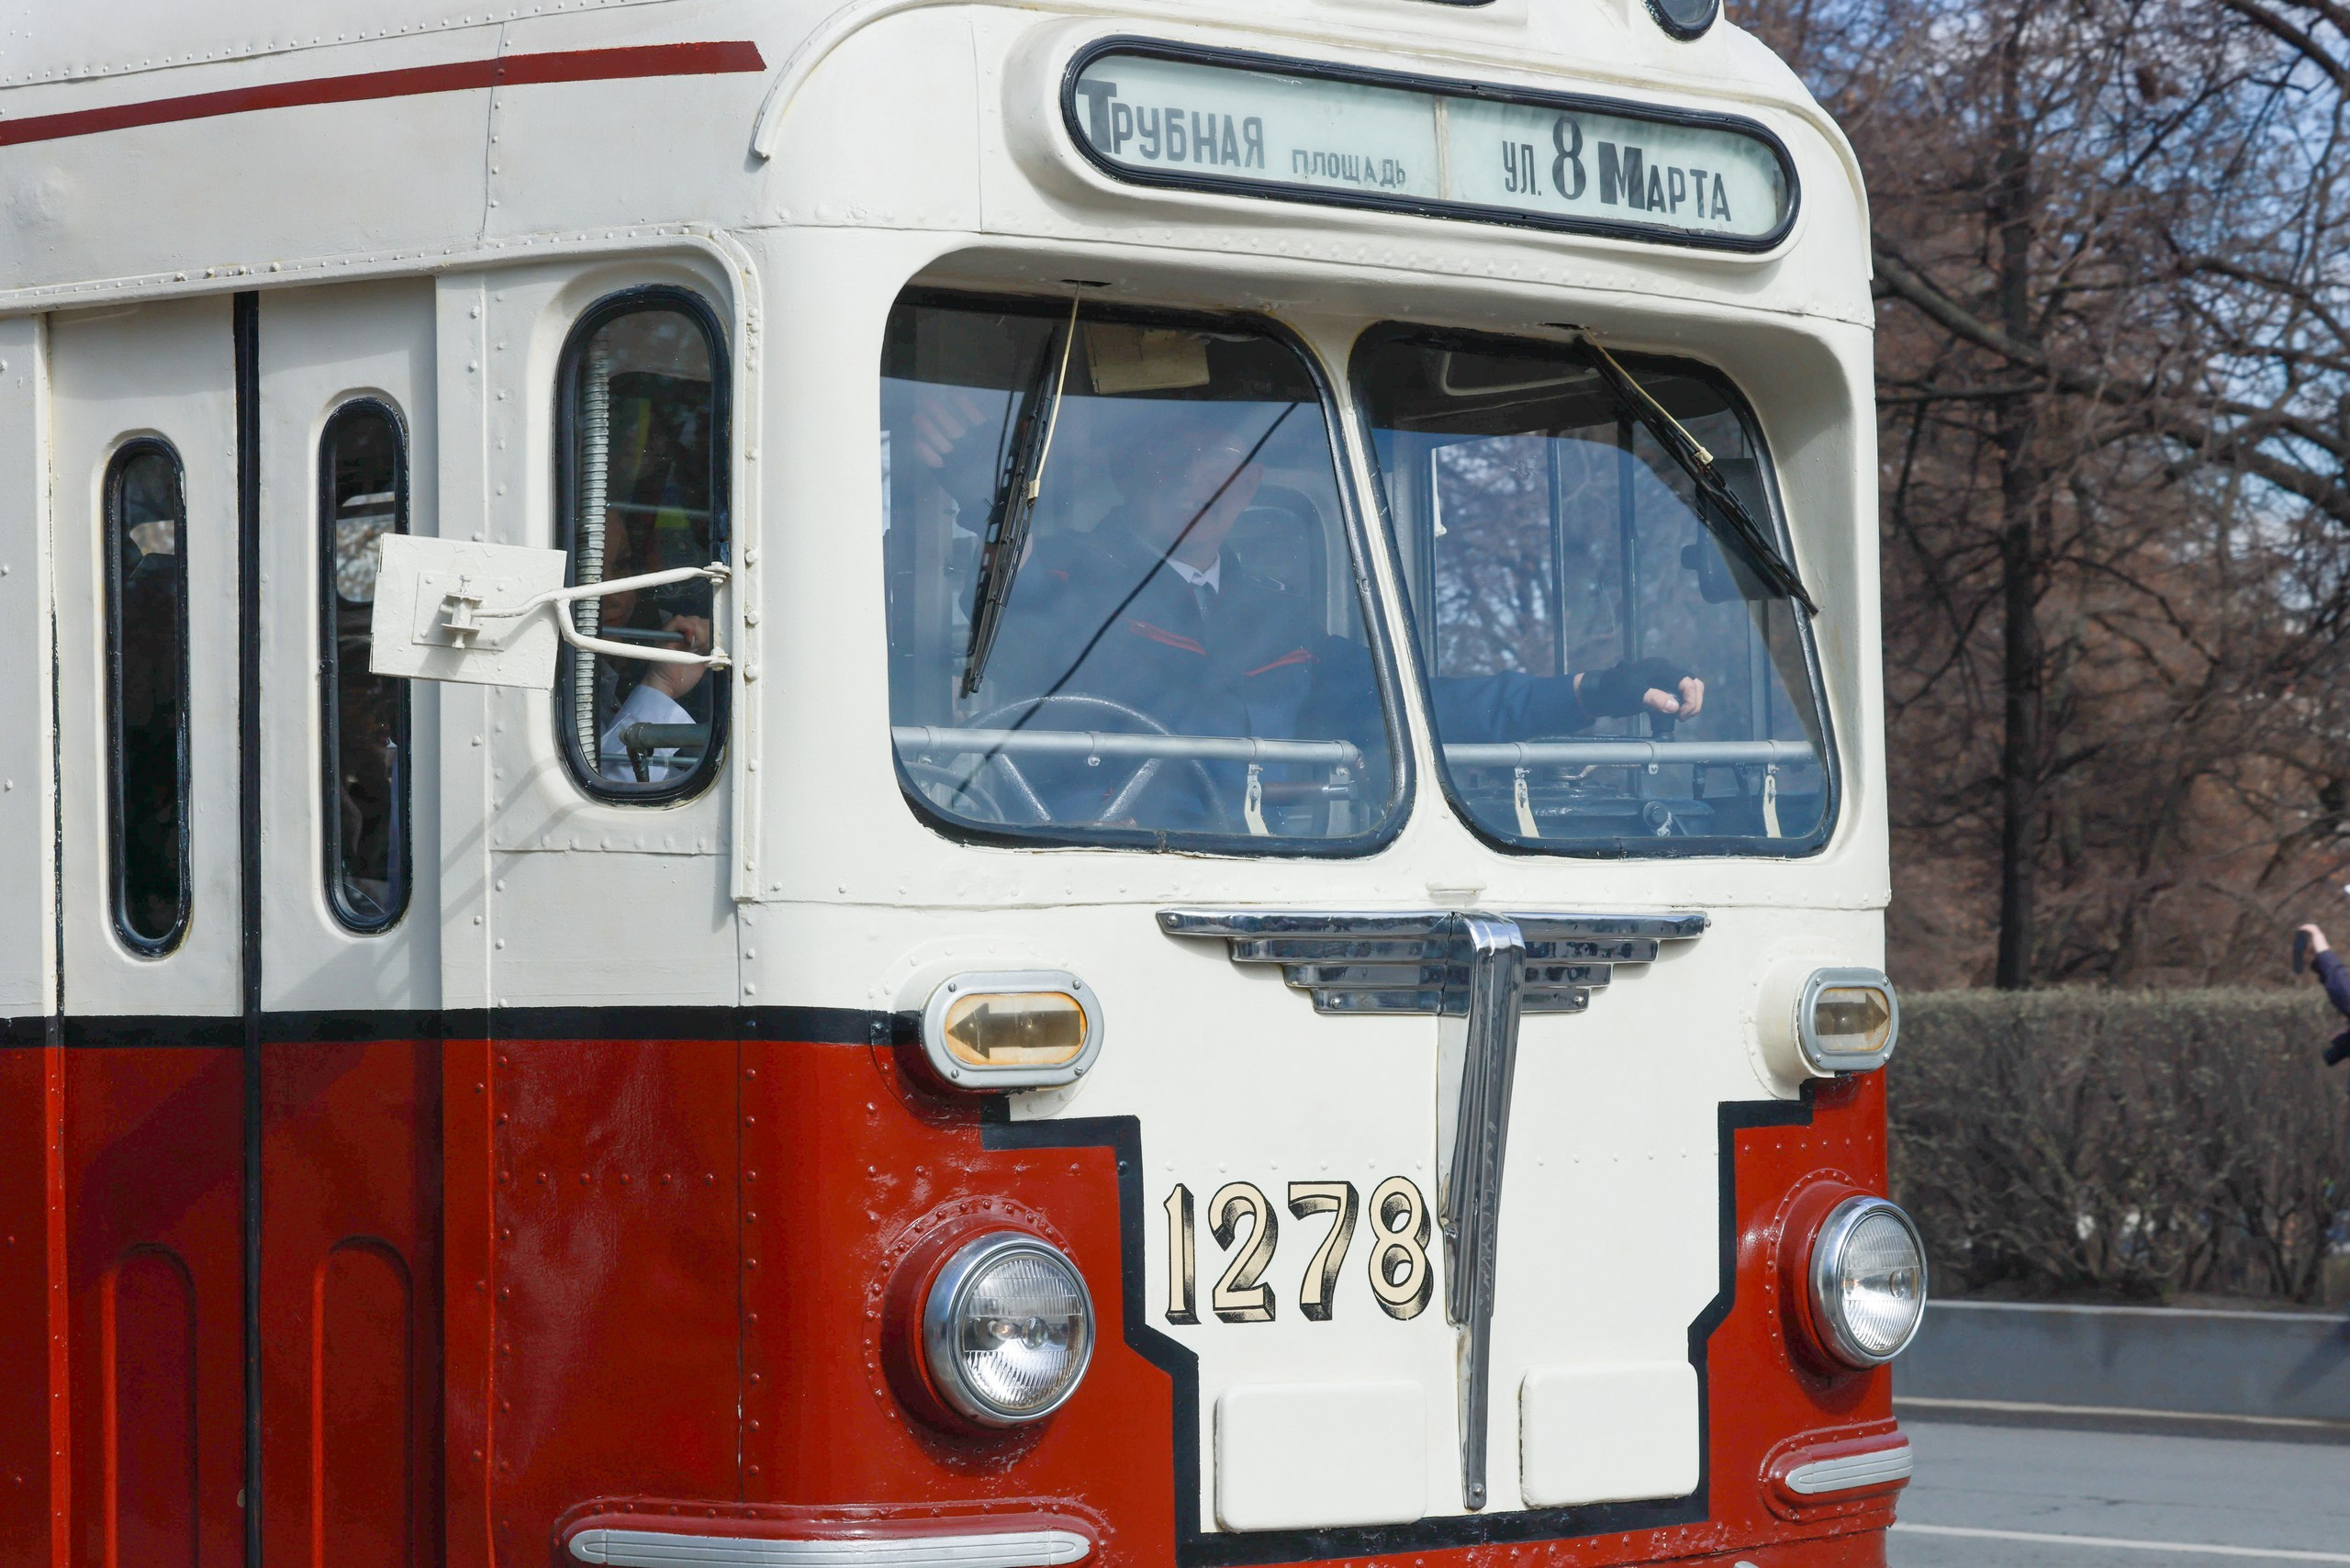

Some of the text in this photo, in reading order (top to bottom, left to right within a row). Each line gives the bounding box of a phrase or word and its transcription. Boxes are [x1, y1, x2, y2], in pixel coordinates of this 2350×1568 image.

[1077, 79, 1406, 188] ТРУБНАЯ ПЛОЩАДЬ
[1551, 116, 1586, 200] 8
[1597, 140, 1731, 222] МАРТА
[1163, 1175, 1434, 1326] 1278
